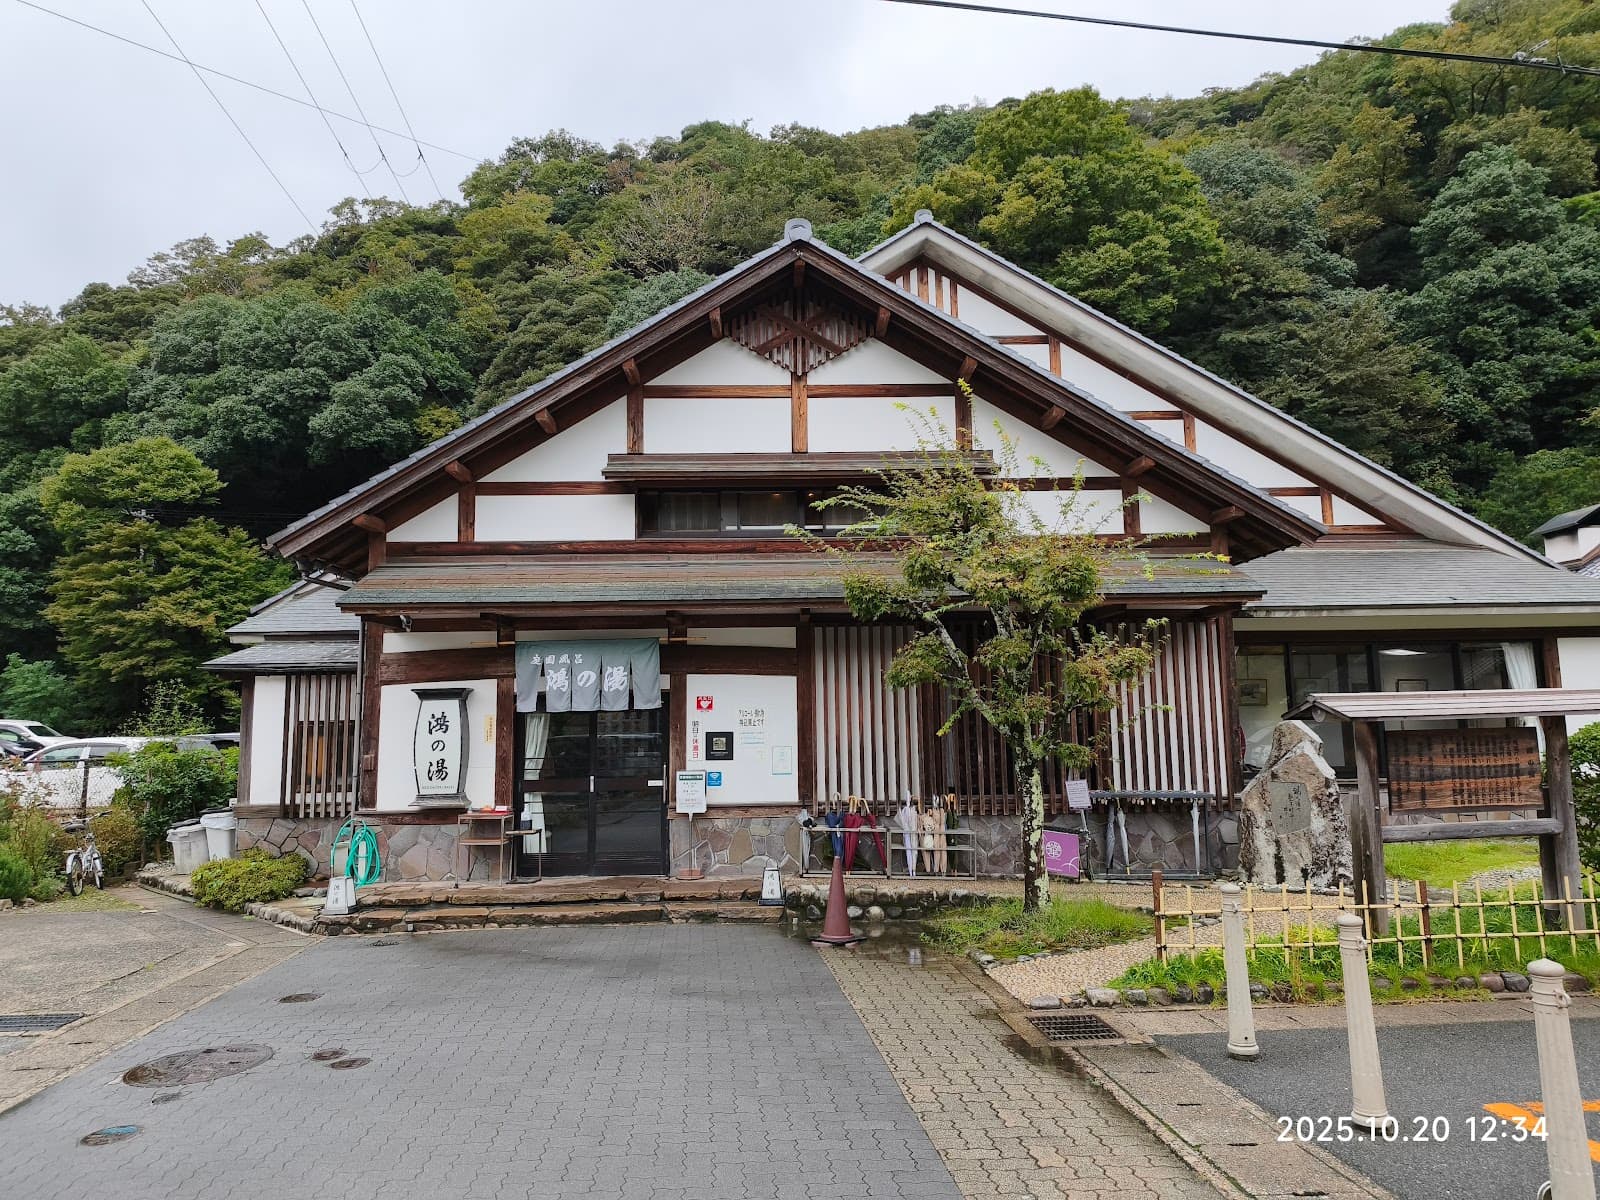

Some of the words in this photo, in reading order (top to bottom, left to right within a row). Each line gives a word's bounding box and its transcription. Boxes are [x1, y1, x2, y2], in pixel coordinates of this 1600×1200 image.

[546, 666, 628, 693] 鴻の湯
[427, 711, 450, 781] 鴻の湯
